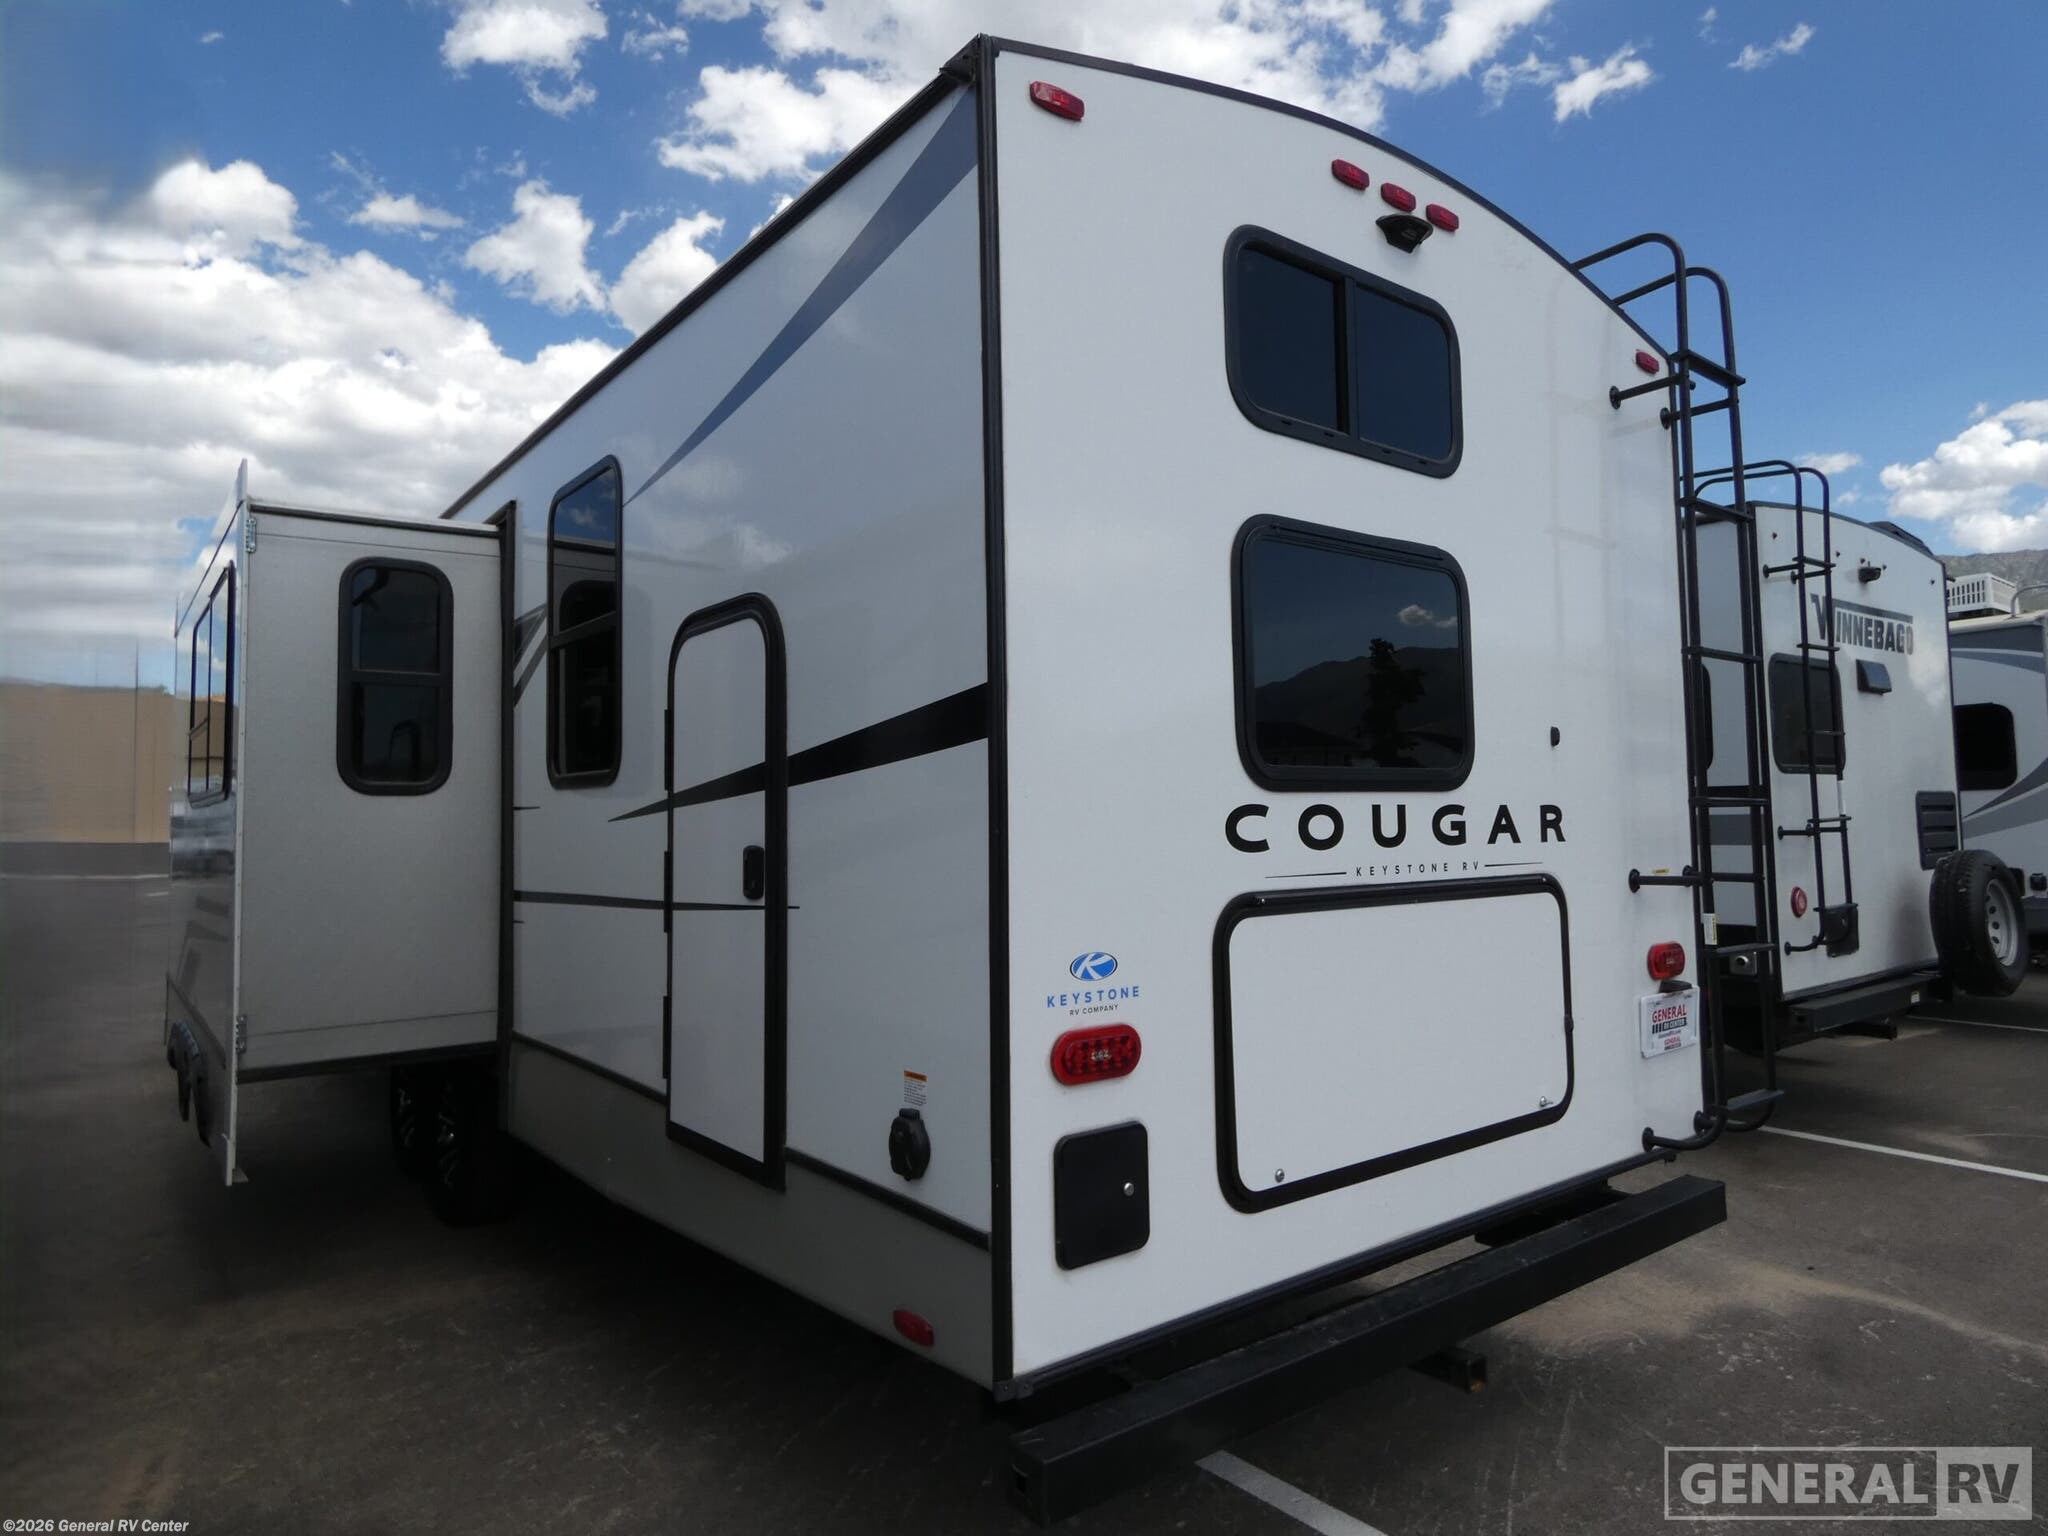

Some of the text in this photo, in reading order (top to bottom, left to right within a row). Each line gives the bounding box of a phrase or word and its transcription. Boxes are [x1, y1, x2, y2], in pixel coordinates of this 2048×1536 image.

[1225, 803, 1566, 853] COUGAR
[1355, 861, 1479, 877] KEYSTONE RV
[1047, 986, 1140, 1008] KEYSTONE
[1082, 1004, 1119, 1014] COMPANY
[1652, 1004, 1687, 1023] GENERAL
